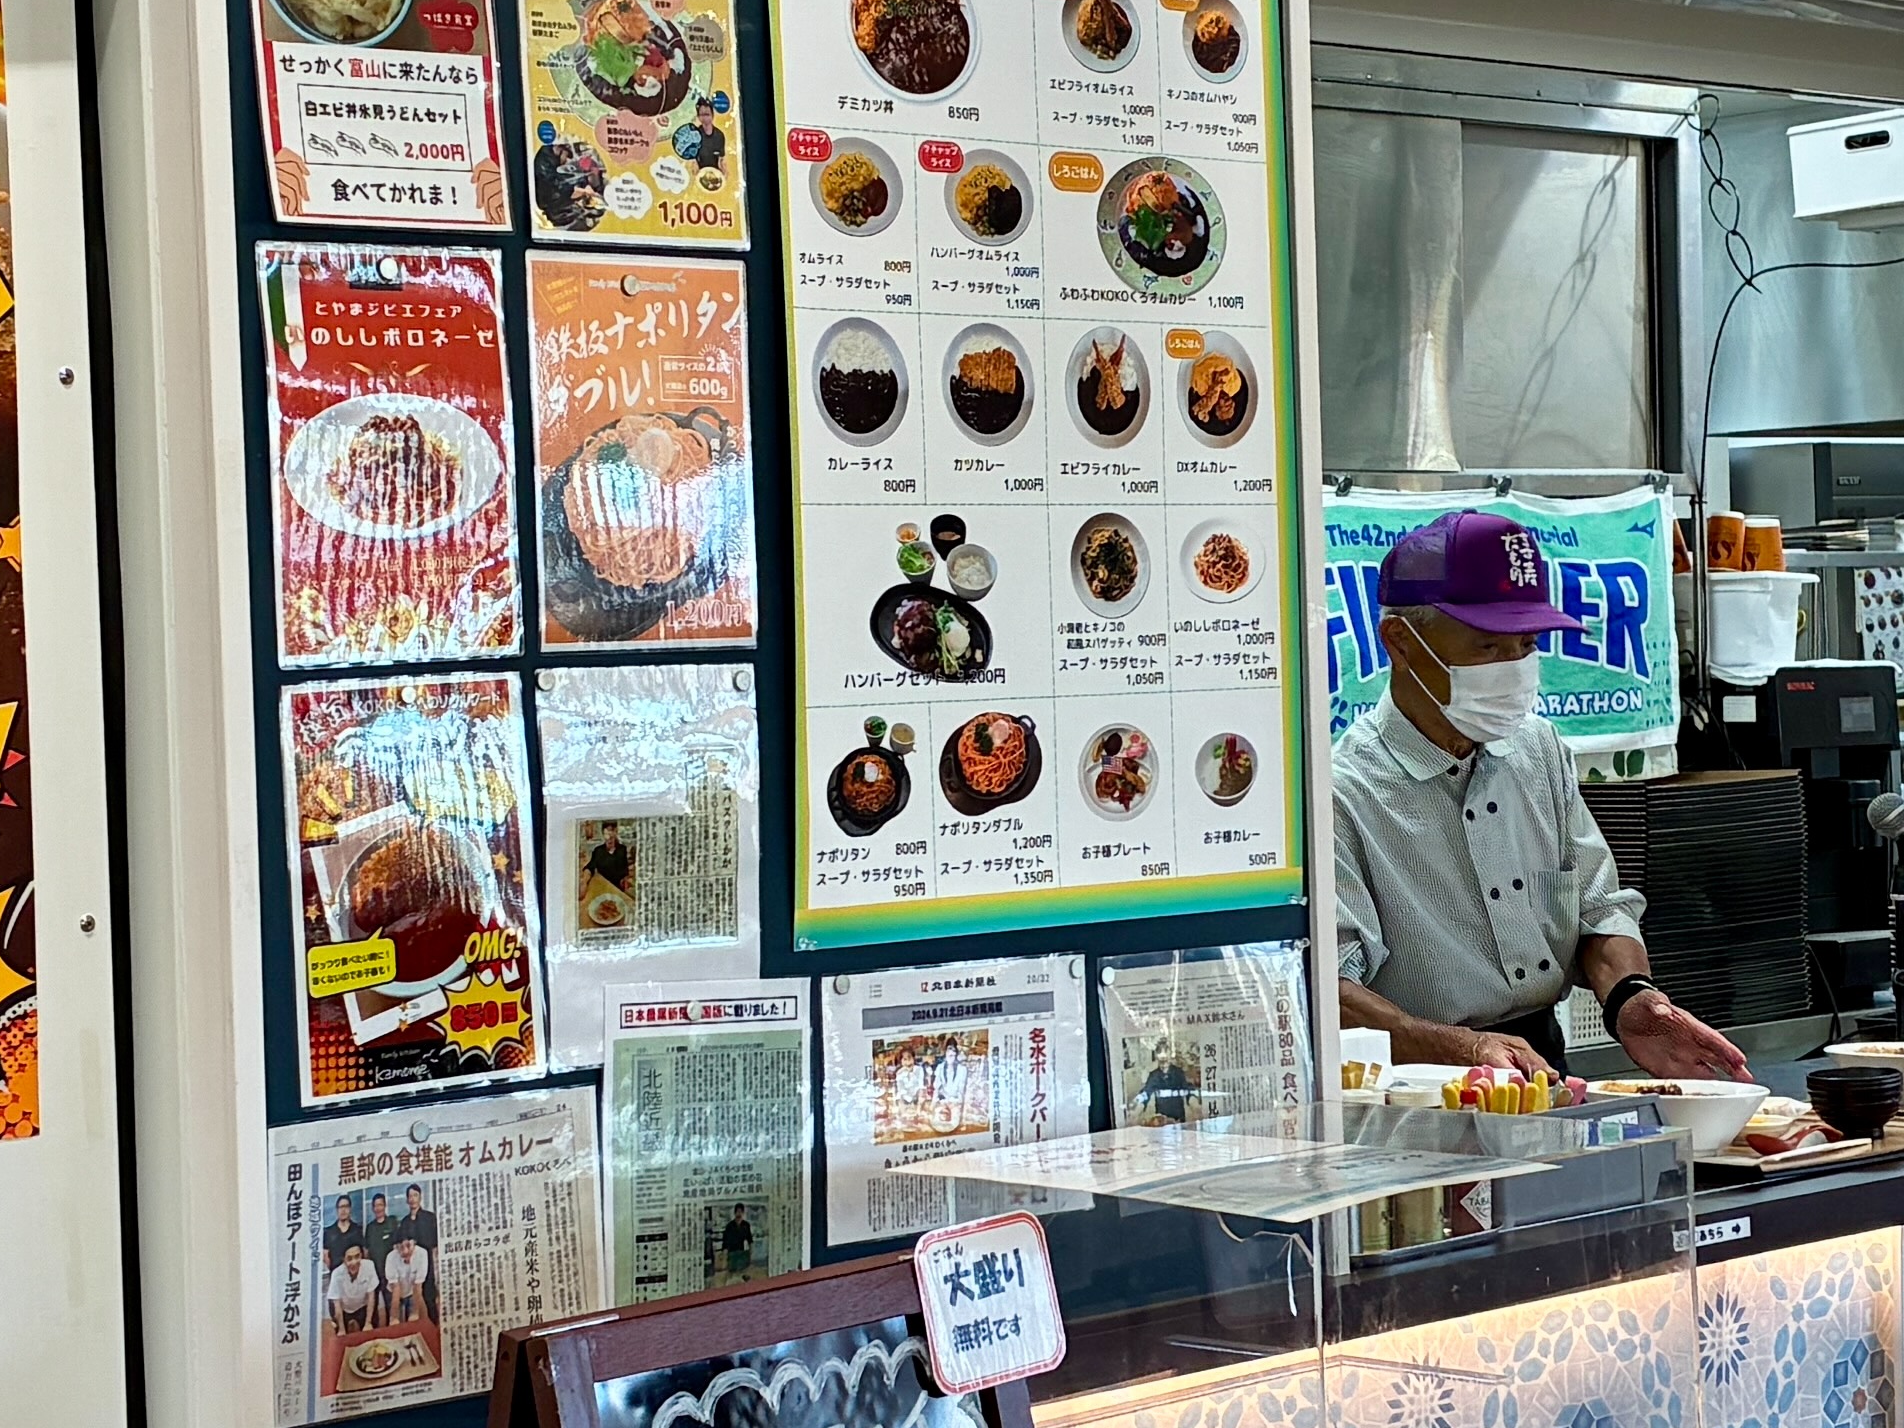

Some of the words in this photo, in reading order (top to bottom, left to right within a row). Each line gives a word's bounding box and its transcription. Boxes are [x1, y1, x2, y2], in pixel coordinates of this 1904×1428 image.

[279, 54, 480, 86] せっかく富山に来たんなら
[1050, 79, 1134, 96] エビフライオムライス
[838, 95, 894, 114] デミカツ丼
[948, 106, 980, 122] 850円
[1053, 112, 1136, 129] スープ・サラダセット
[404, 141, 467, 164] 2,000円
[1054, 165, 1099, 181] しろごはん
[331, 178, 461, 206] 食べてかれま！
[658, 200, 733, 229] 1,100円
[799, 253, 844, 265] オムライス
[800, 274, 891, 290] スープ・サラダセット
[931, 280, 1021, 296] スープ・サラダセット
[885, 294, 912, 306] 950円
[1208, 296, 1244, 310] 1,100円
[314, 301, 462, 318] とやまジビエフェア
[284, 324, 496, 349] いのししボロネーゼ
[688, 377, 729, 399] 600g
[827, 456, 894, 471] カレーライス
[953, 457, 1006, 472] カツカレー
[1060, 461, 1141, 476] エビフライカレー
[883, 478, 916, 493] 800円
[1003, 477, 1044, 493] 1,000円
[1120, 479, 1159, 494] 1,000円
[1233, 477, 1273, 493] 1,200円
[1174, 617, 1260, 633] いのししボロネーゼ
[1138, 634, 1167, 648] 900円
[1236, 631, 1275, 646] 1,000円
[1059, 656, 1158, 671] スープ・サラダセット
[1175, 651, 1271, 667] スープ・サラダセット
[1125, 672, 1165, 686] 1,050円
[1238, 666, 1277, 681] 1,150円
[938, 818, 1023, 836] ナポリタンダブル
[1012, 834, 1053, 850] 1,200円
[1203, 828, 1261, 845] お子様カレー
[815, 846, 871, 863] ナポリタン
[895, 840, 927, 856] 800円
[1082, 841, 1151, 860] お子様プレート
[940, 855, 1045, 876] スープ・サラダセット
[1249, 851, 1277, 867] 500円
[815, 865, 925, 886] スープ・サラダセット
[1014, 869, 1054, 885] 1,350円
[1141, 862, 1170, 878] 850円
[893, 881, 926, 898] 950円
[464, 927, 525, 964] OMG!
[450, 1000, 519, 1033] 850円
[338, 1143, 455, 1186] 黒部の食堪能
[458, 1133, 554, 1168] オムカレー
[444, 1233, 511, 1254] 出店者らコラボ
[281, 1163, 303, 1345] 田んぼアート浮かぶ
[943, 1248, 1026, 1307] 大盛り
[954, 1315, 1024, 1354] 無料です
